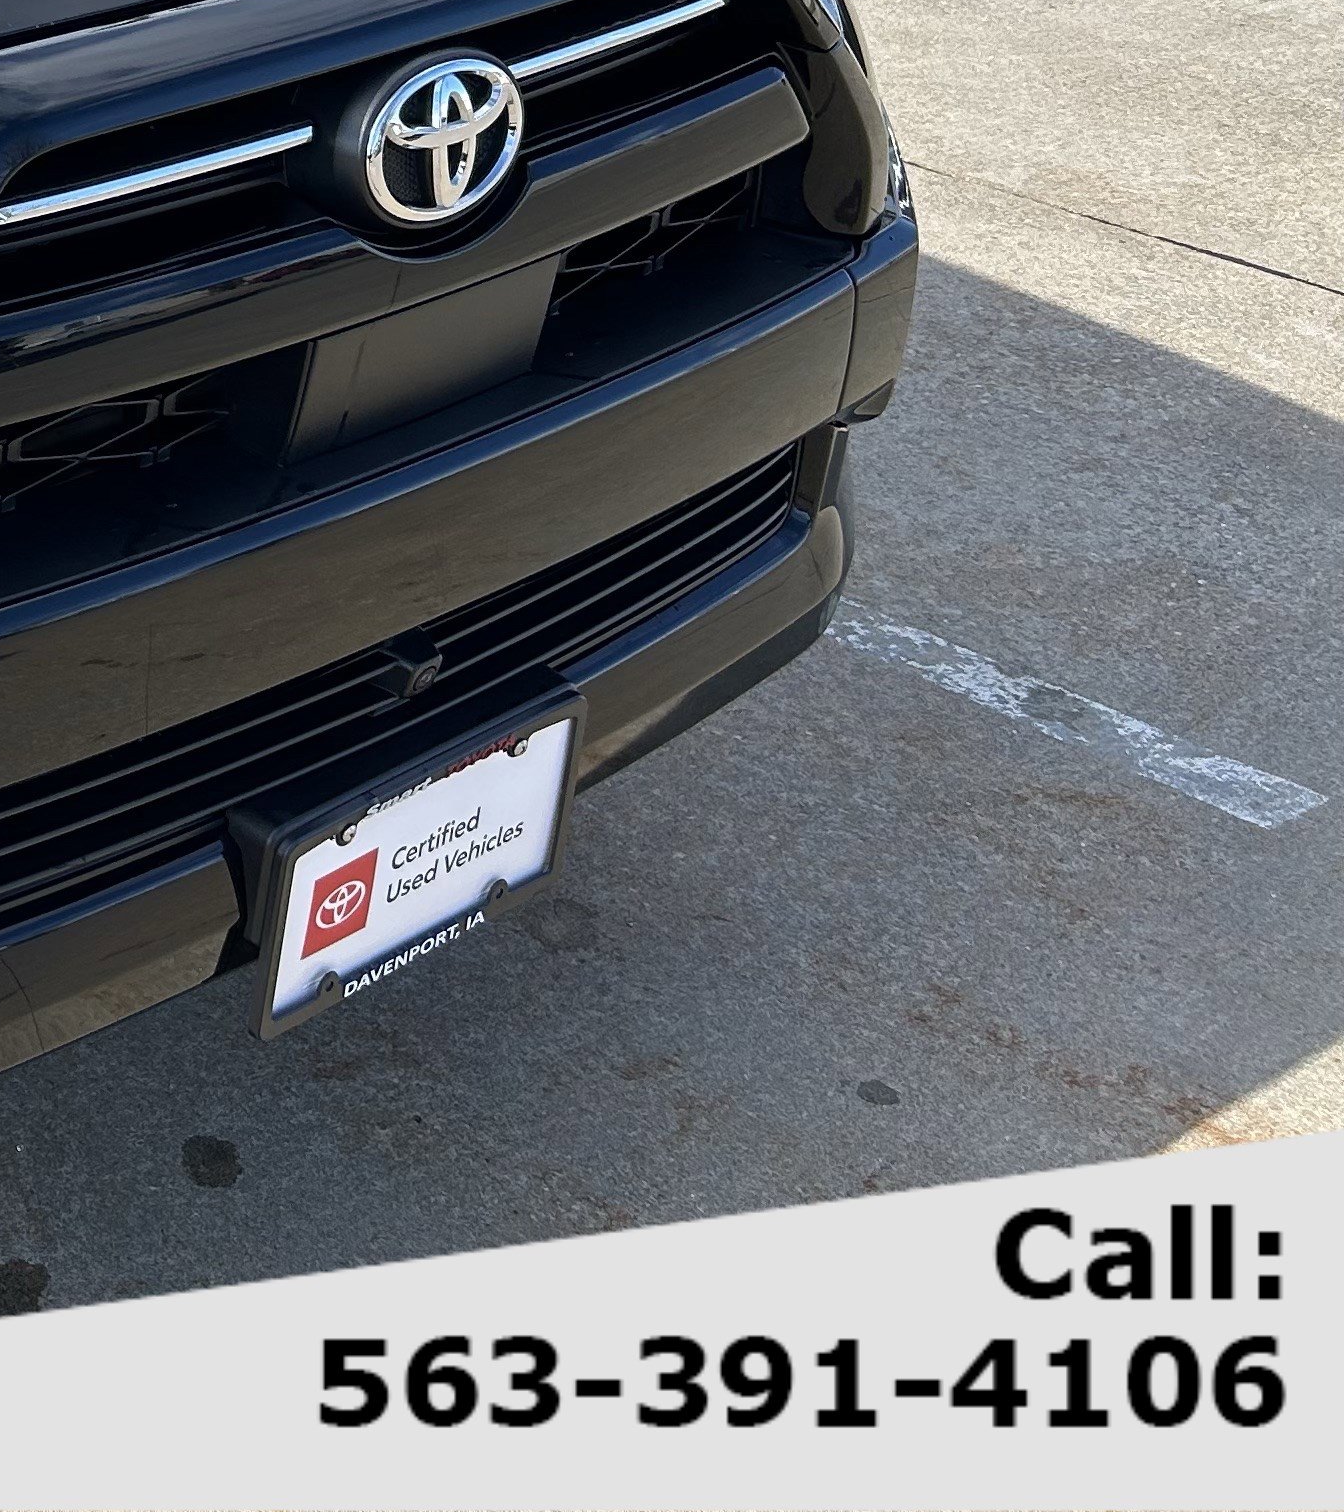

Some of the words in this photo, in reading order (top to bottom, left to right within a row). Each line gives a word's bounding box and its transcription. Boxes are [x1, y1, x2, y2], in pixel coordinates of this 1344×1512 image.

[367, 776, 433, 816] Smart
[386, 859, 439, 903] Used
[444, 821, 524, 874] Vehicles
[391, 806, 482, 870] Certified
[343, 922, 460, 998] DAVENPORT,
[465, 910, 485, 931] IA
